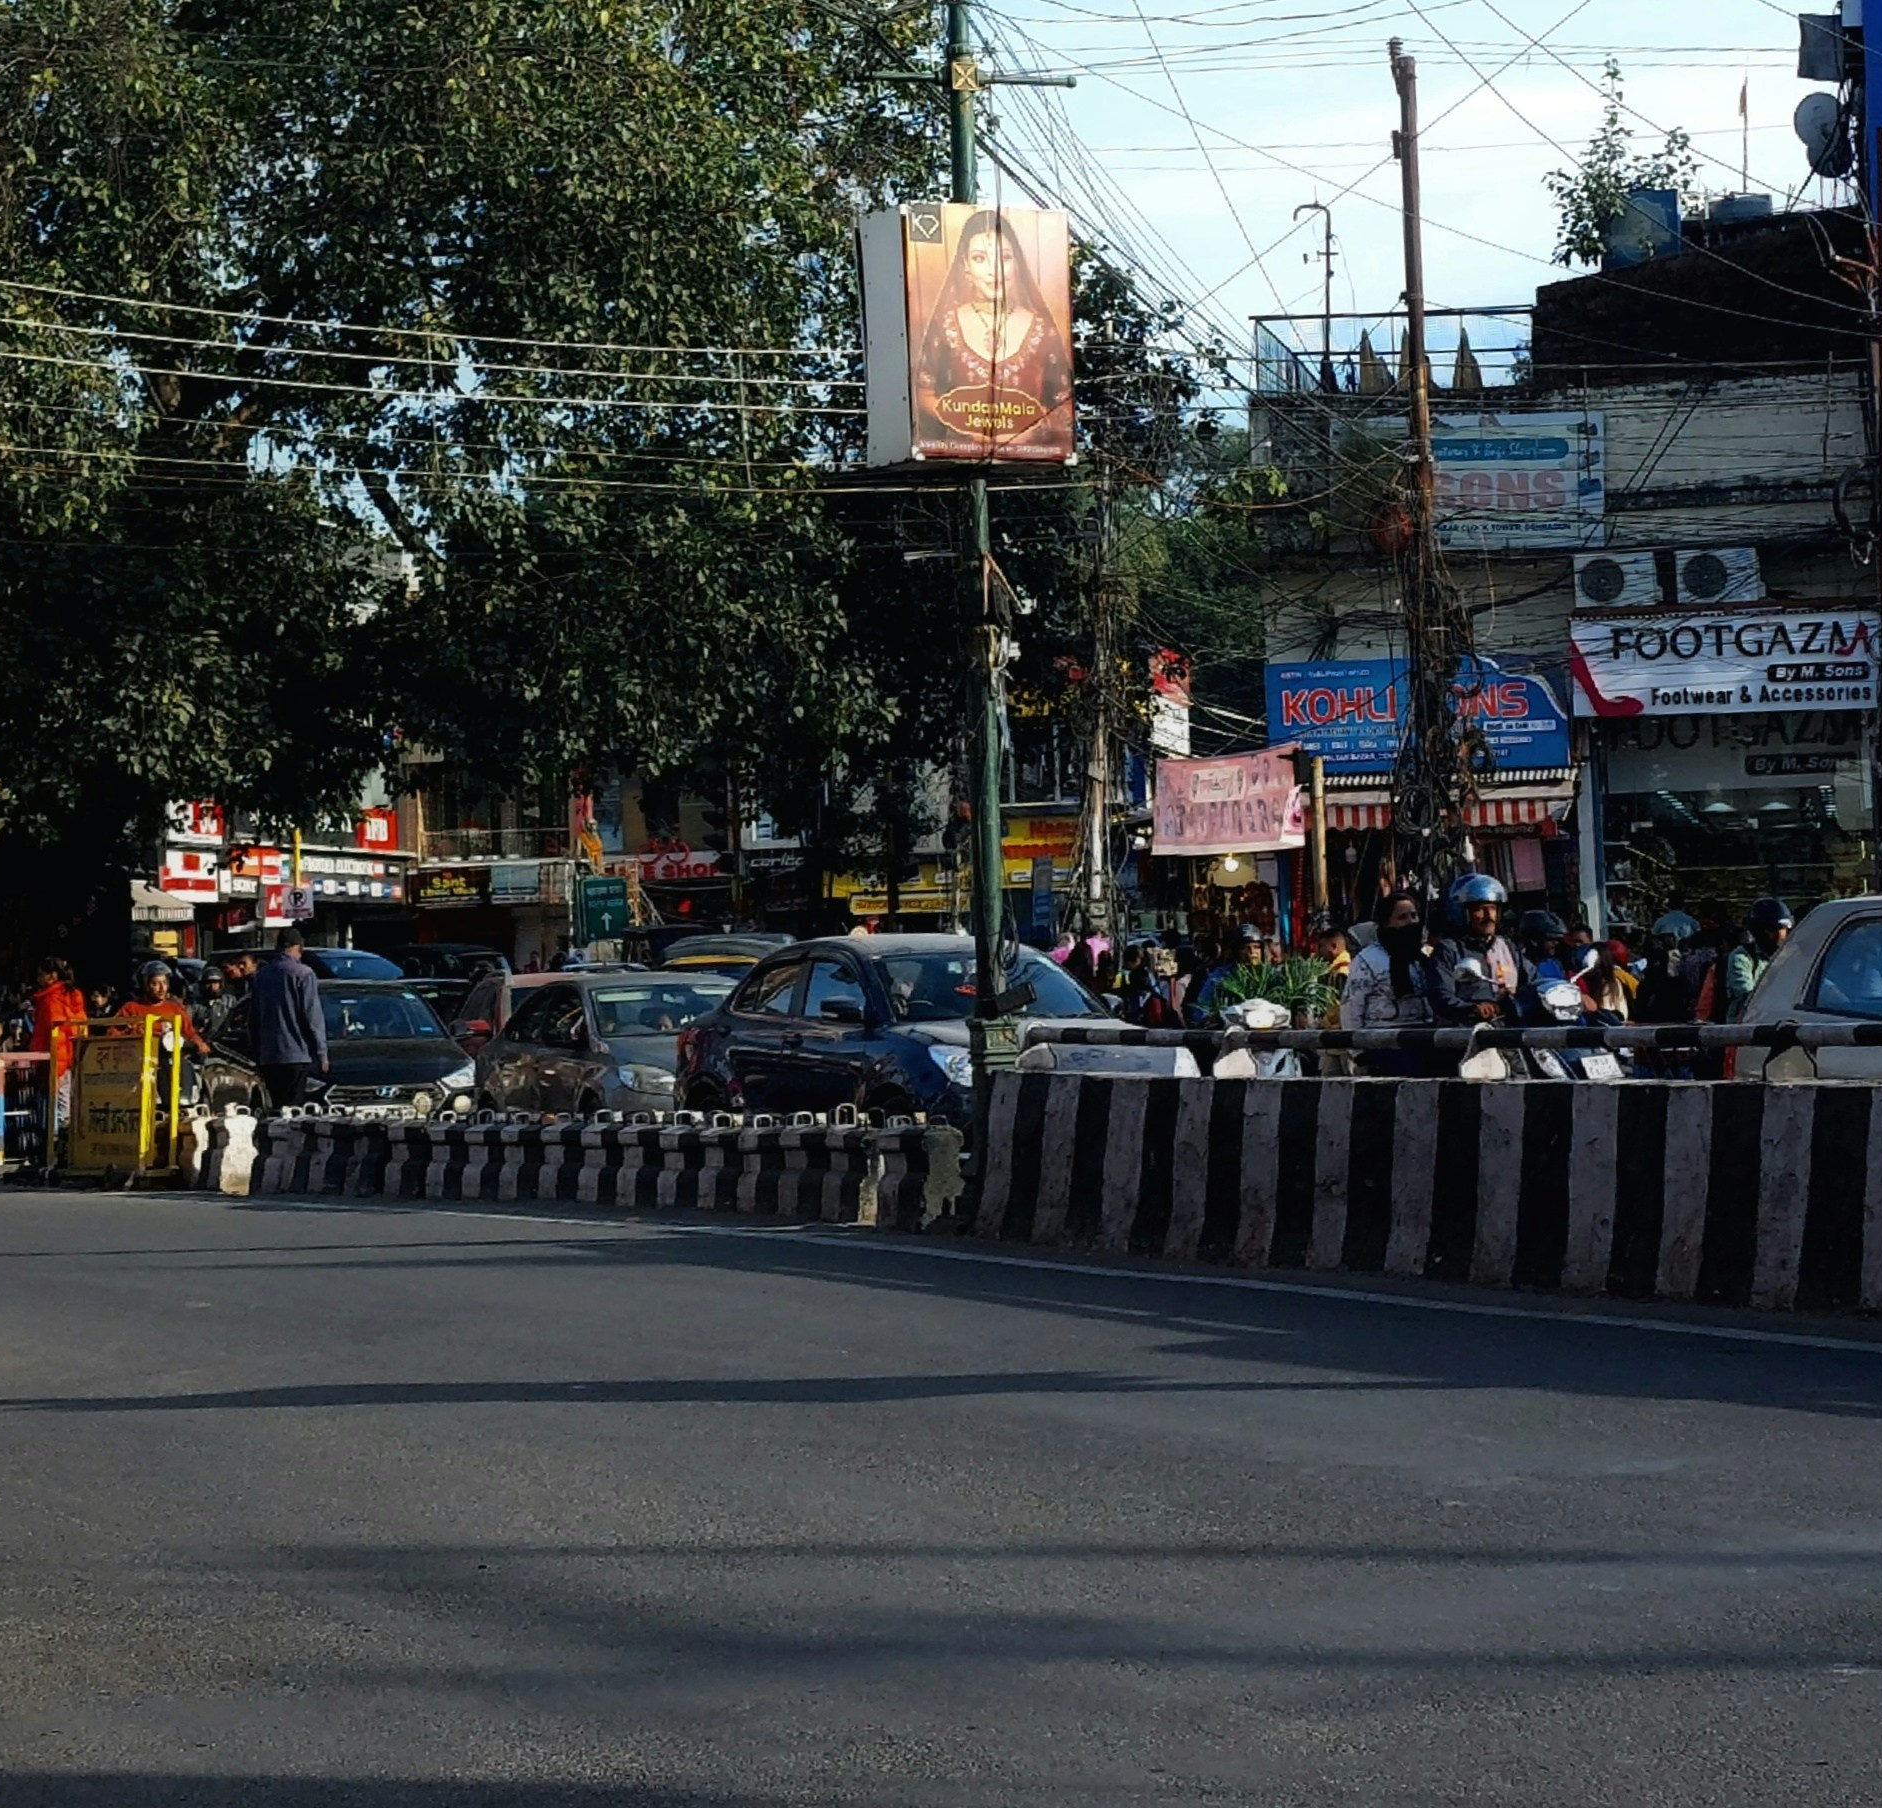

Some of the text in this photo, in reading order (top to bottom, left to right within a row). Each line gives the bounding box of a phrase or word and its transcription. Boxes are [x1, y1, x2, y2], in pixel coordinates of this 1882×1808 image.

[965, 415, 1014, 429] Jewels
[1775, 664, 1863, 681] By M. Sons
[1282, 682, 1529, 726] KOHLI ONS
[1651, 685, 1871, 707] Footwear & Accessories
[1754, 757, 1775, 773] By
